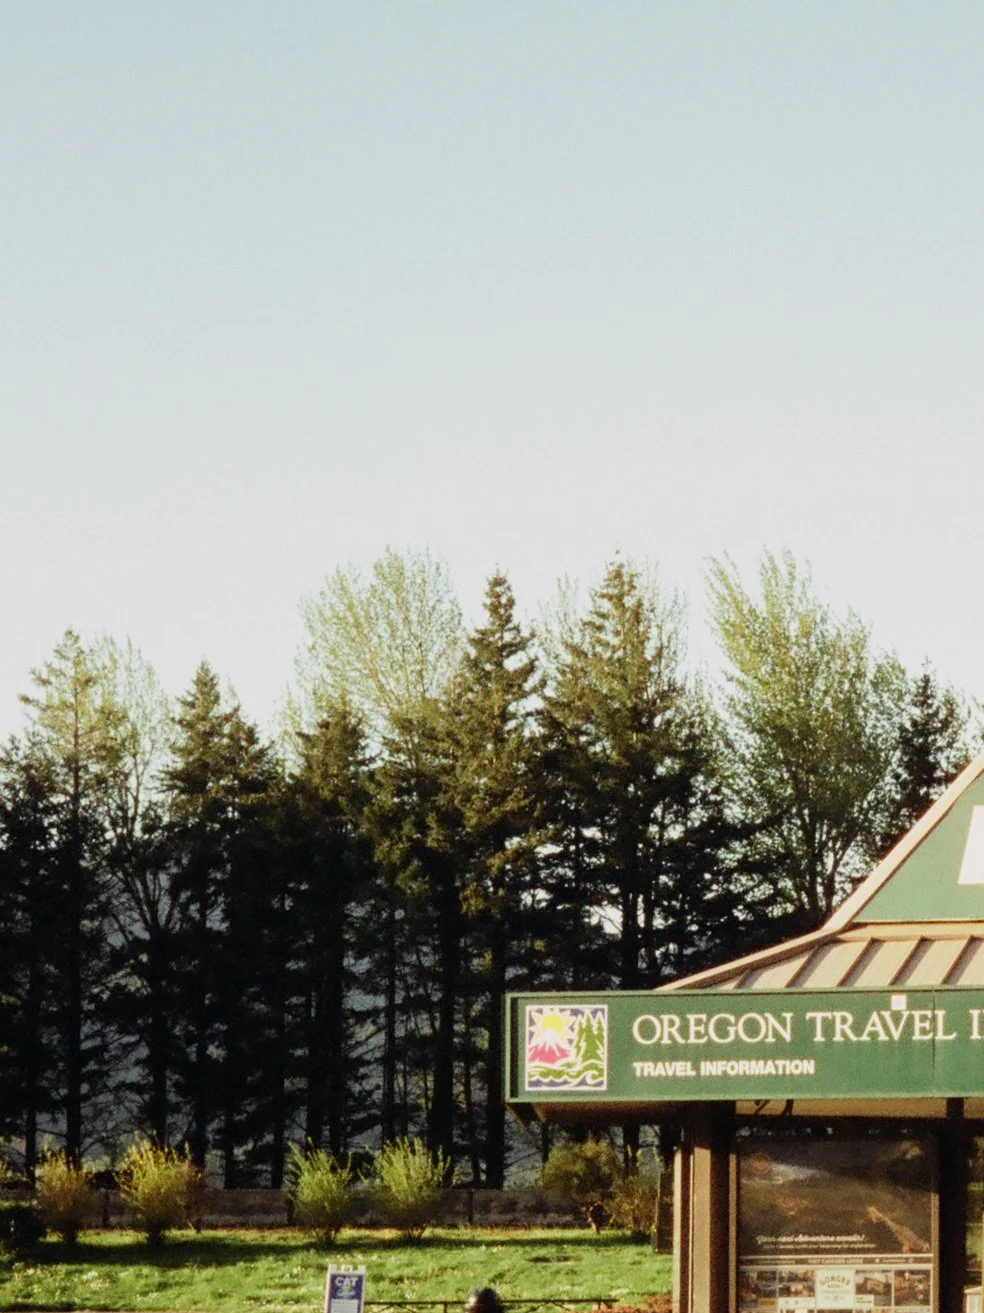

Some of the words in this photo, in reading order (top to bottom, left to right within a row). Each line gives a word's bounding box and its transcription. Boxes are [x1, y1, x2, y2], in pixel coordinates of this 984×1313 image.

[632, 1012, 794, 1045] OREGON
[805, 1009, 957, 1042] TRAVEL
[633, 1061, 696, 1077] TRAVEL
[701, 1059, 815, 1076] INFORMATION
[335, 1276, 358, 1287] CAT
